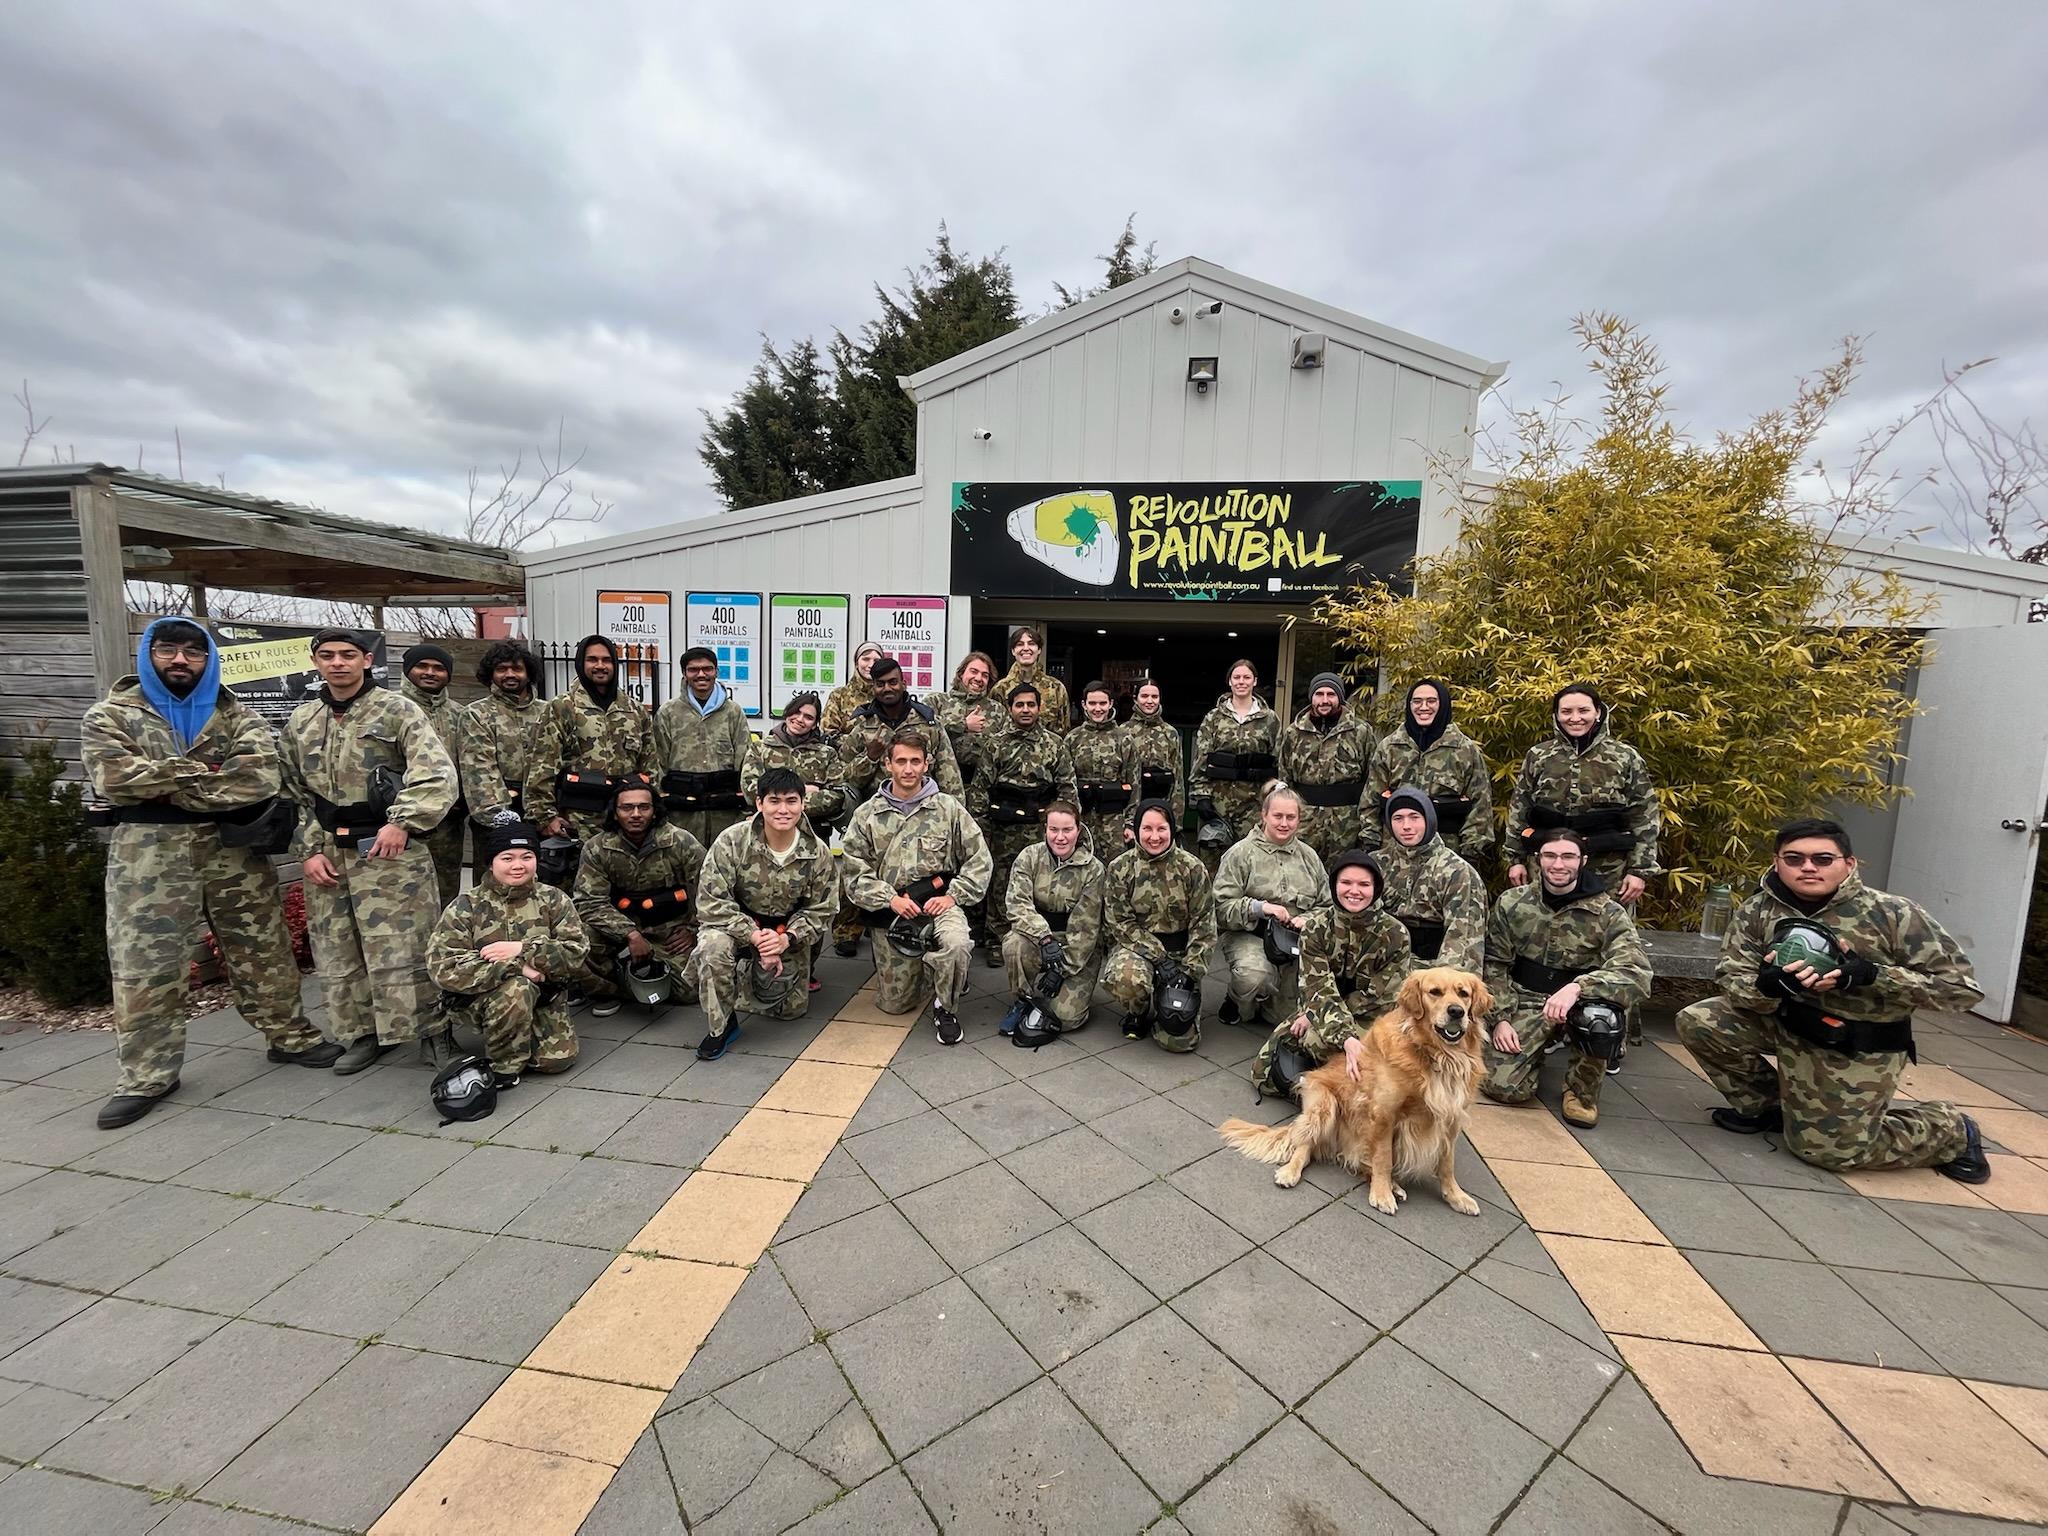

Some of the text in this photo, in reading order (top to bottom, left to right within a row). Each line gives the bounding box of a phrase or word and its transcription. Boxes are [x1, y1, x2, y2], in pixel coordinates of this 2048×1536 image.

[1129, 489, 1292, 529] REVOLUTION
[1128, 521, 1343, 589] PAINTBALL
[1143, 580, 1260, 591] www.revolutionpaintball.com.au
[623, 605, 645, 622] 200
[712, 607, 735, 624] 400
[797, 608, 821, 626] 800
[892, 611, 922, 628] 1400
[610, 623, 657, 634] PAINTBALLS
[700, 625, 747, 636] PAINTBALLS
[784, 627, 834, 638] PAINTBALLS
[880, 629, 931, 641] PAINTBALLS
[219, 650, 261, 663] SAFETY
[266, 645, 299, 657] RULES
[222, 658, 297, 676] REGULATIONS
